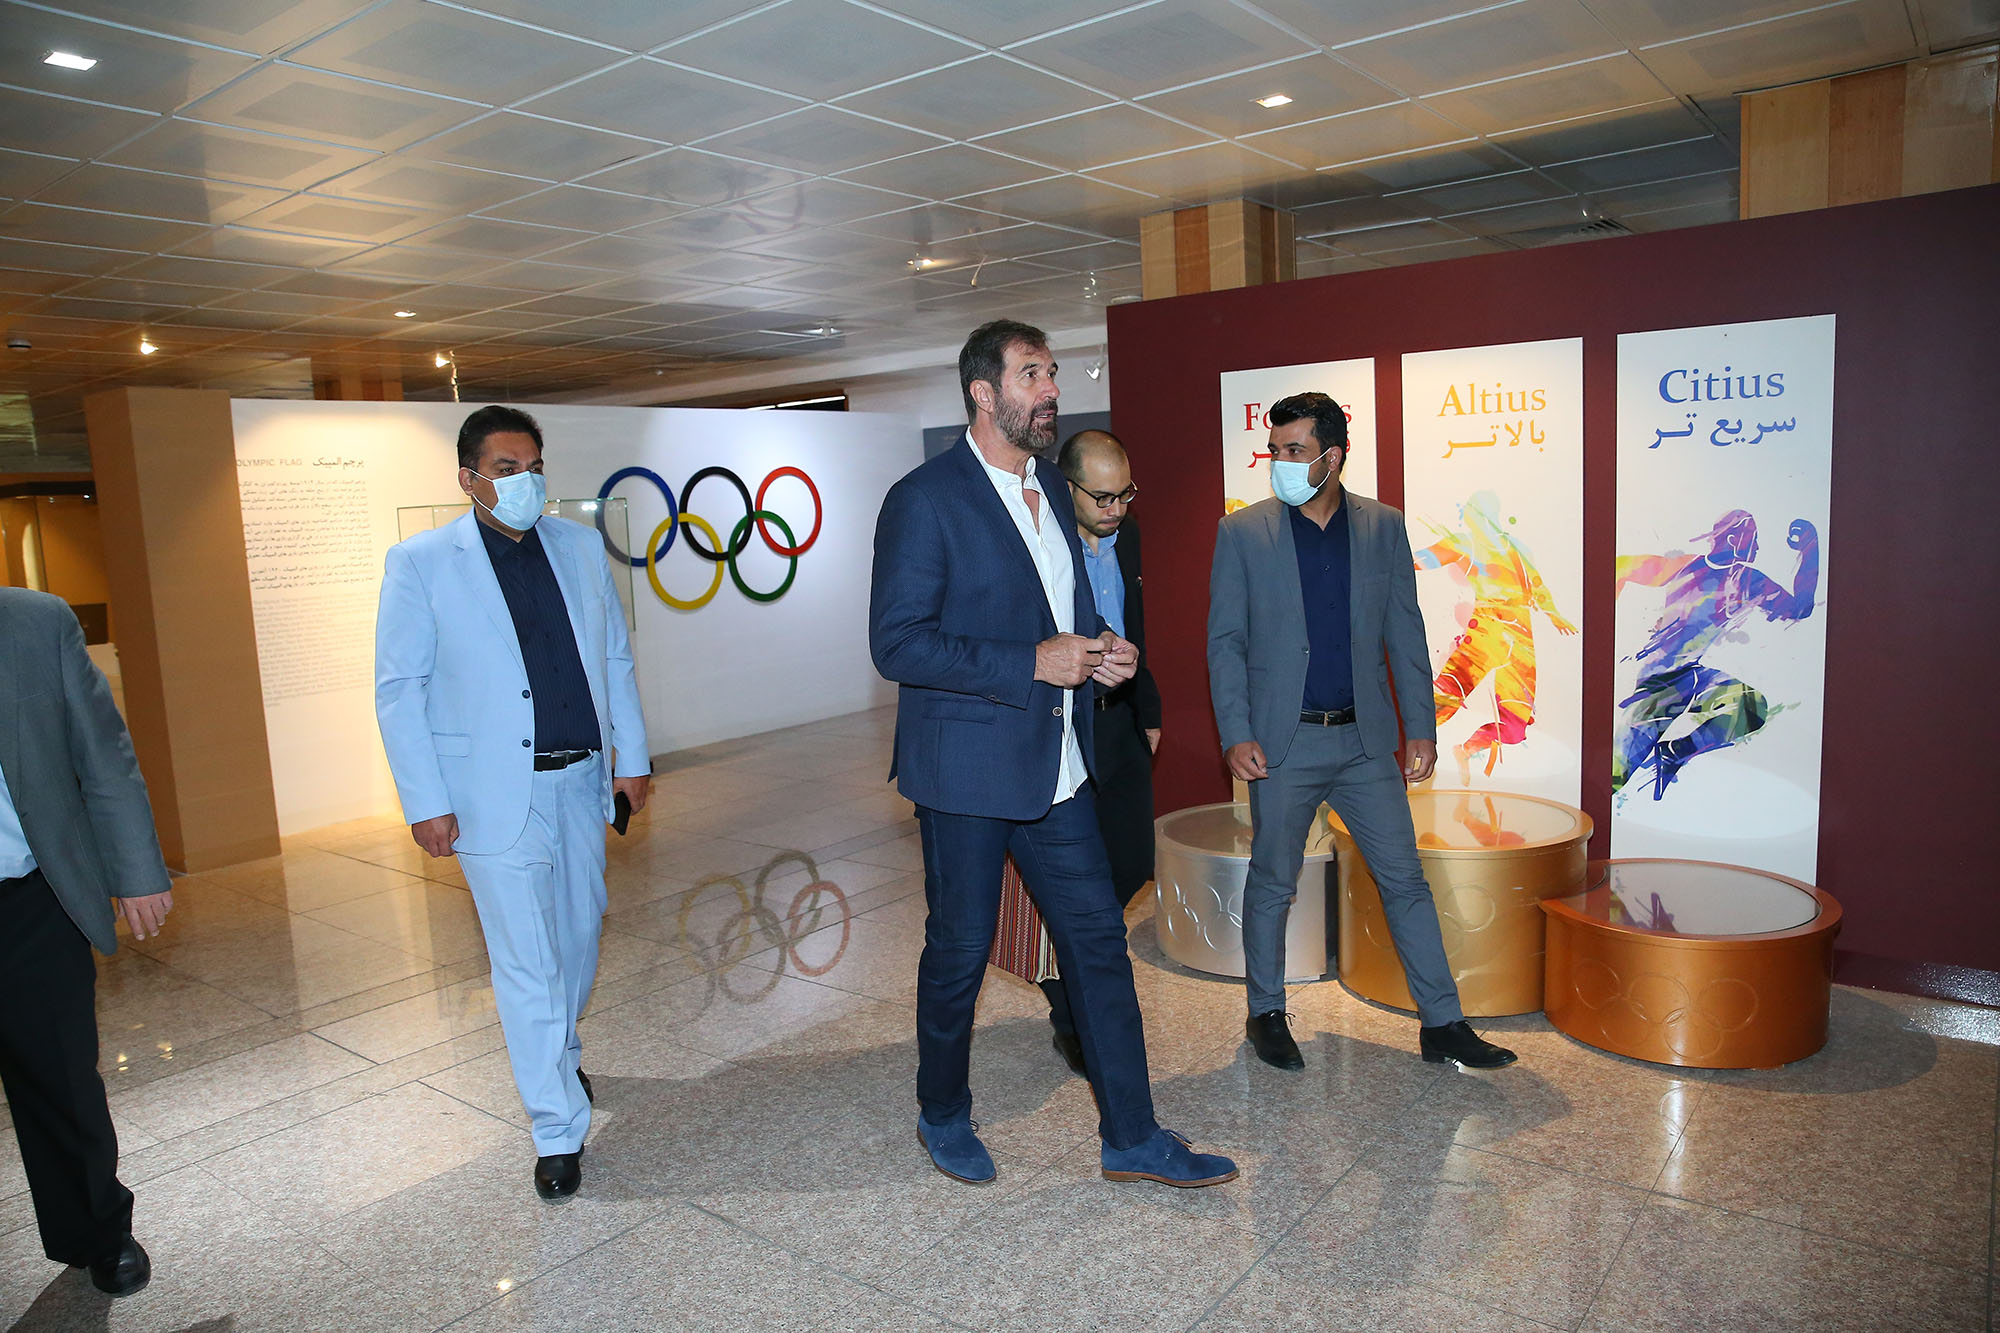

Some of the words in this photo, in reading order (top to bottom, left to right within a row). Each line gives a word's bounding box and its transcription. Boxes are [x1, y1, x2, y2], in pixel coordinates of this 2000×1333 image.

[1437, 382, 1547, 416] Altius
[1658, 366, 1785, 404] Citius
[1647, 412, 1698, 450] تر
[279, 458, 303, 466] FLAG
